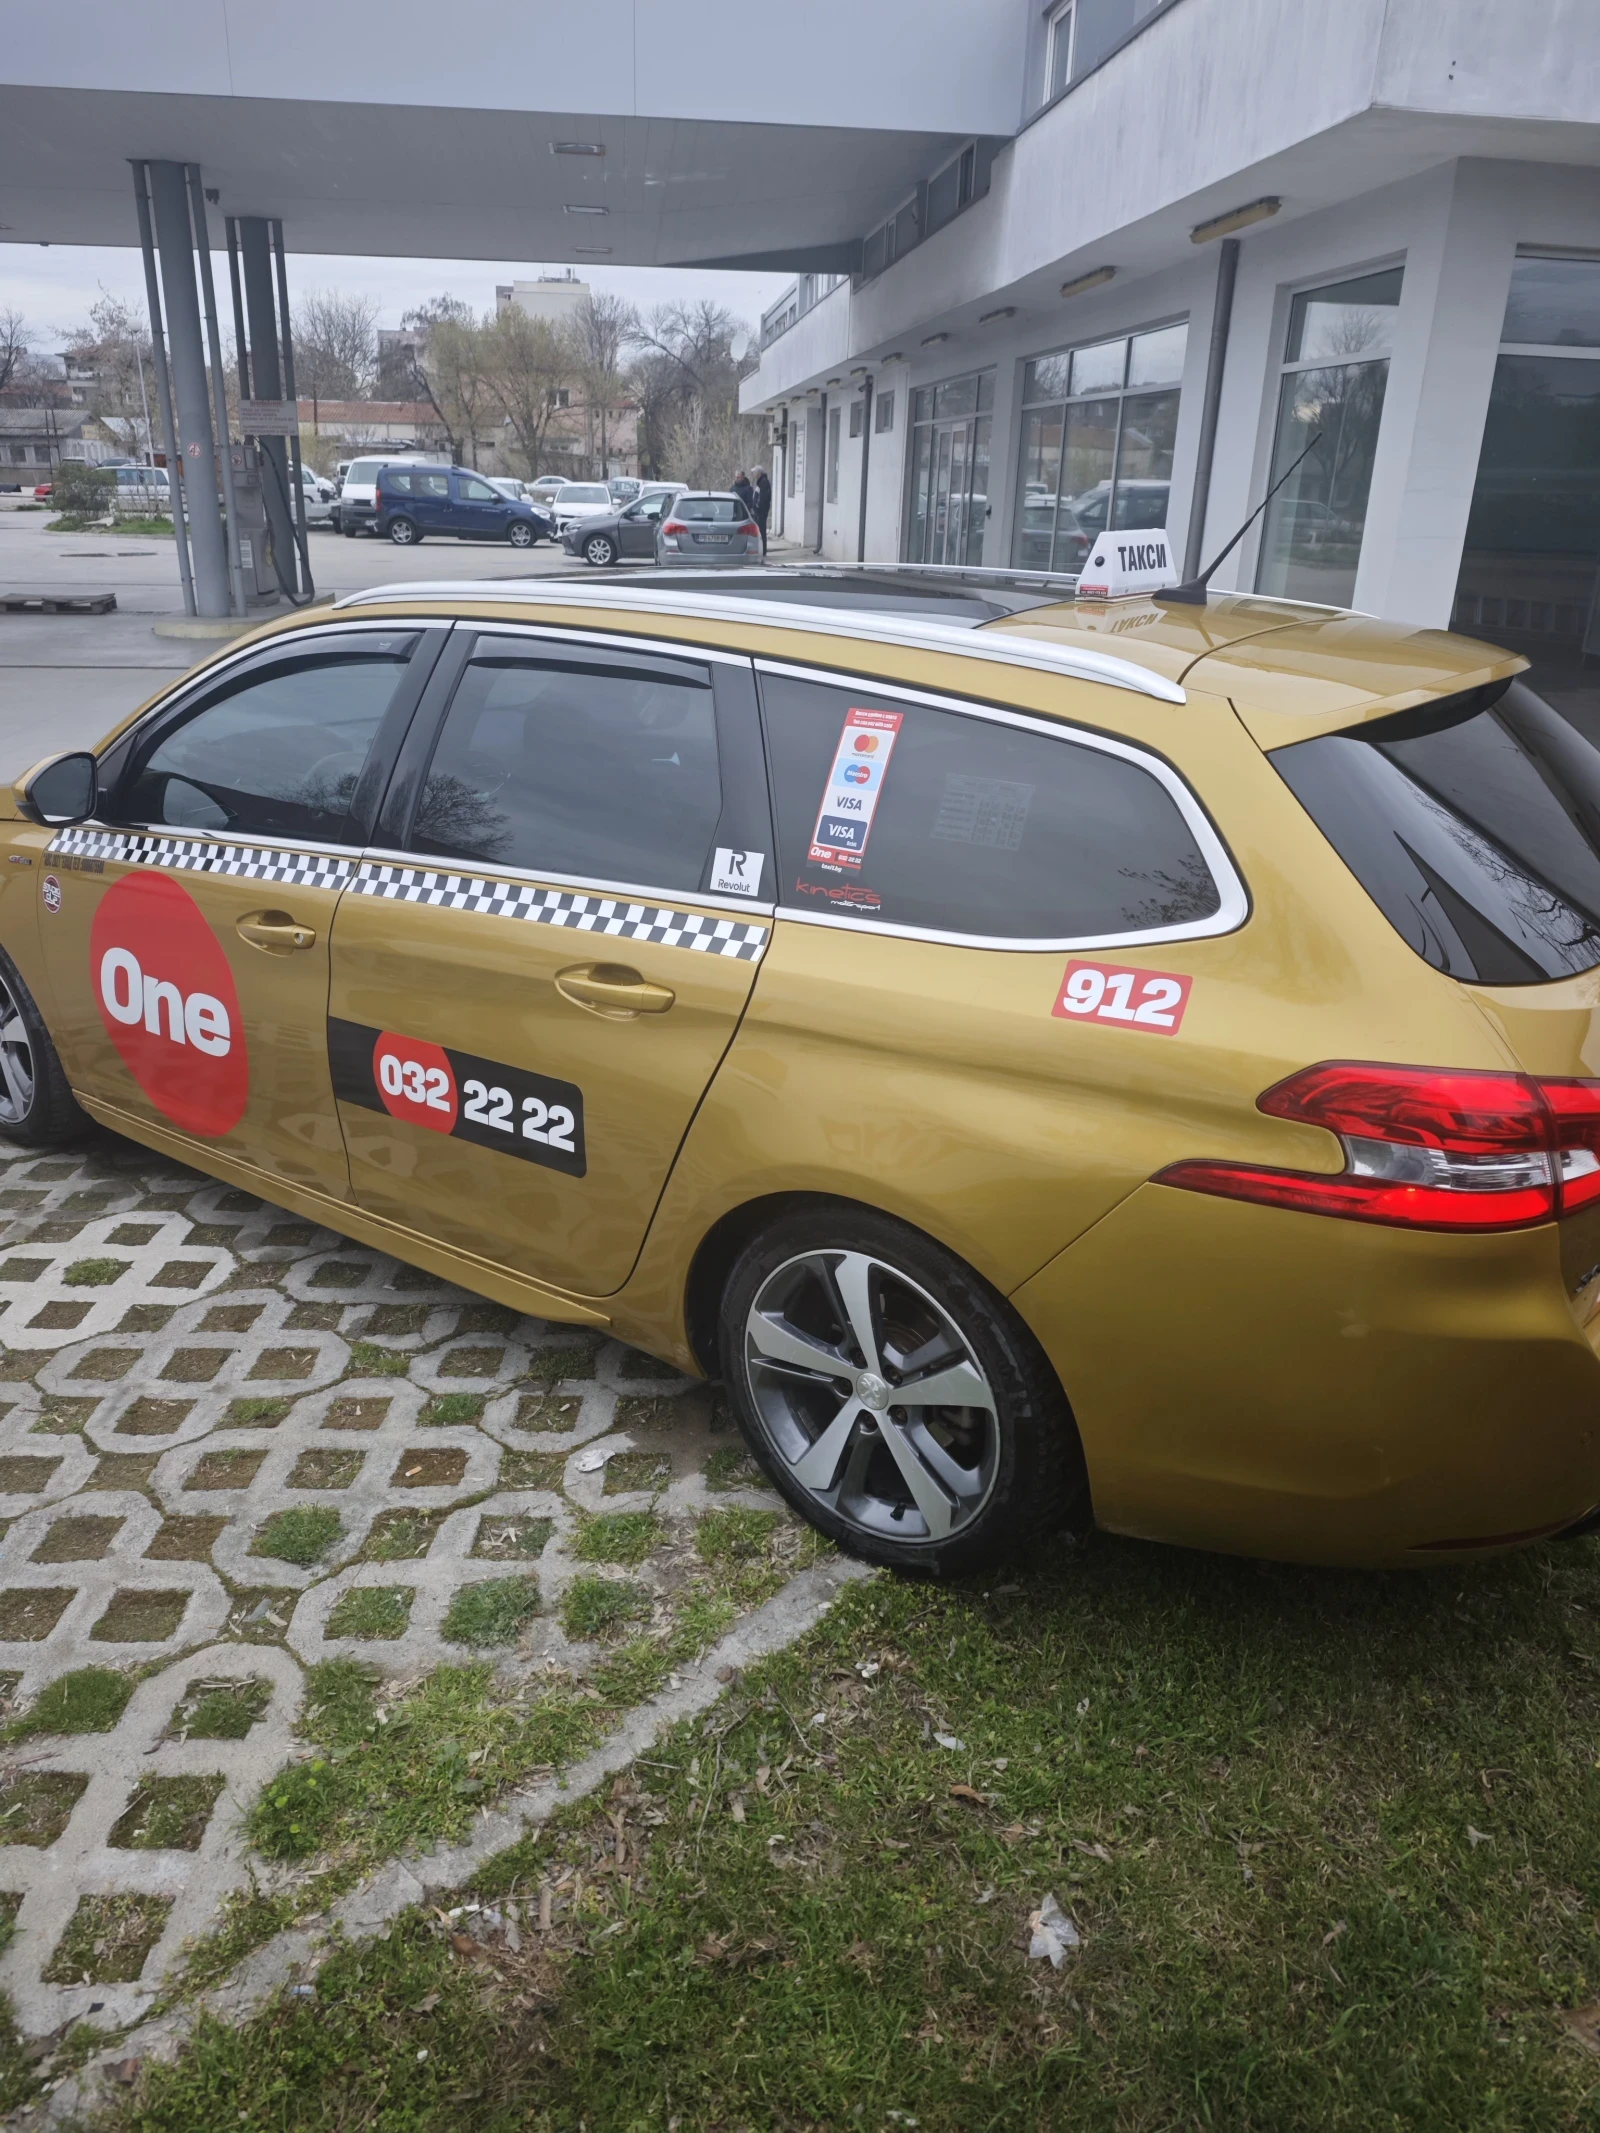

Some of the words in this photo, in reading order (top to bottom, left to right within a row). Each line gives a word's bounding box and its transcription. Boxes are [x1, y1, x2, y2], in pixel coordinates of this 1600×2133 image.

[1117, 543, 1167, 572] ТАКСИ
[847, 770, 868, 779] Maestro
[836, 796, 862, 811] VISA
[828, 823, 855, 840] VISA
[810, 846, 832, 859] One
[718, 879, 750, 892] Revolut
[796, 876, 881, 904] kinetics
[101, 947, 231, 1057] One
[1063, 969, 1182, 1027] 912
[380, 1055, 450, 1113] 032
[464, 1080, 514, 1133] 22
[522, 1097, 575, 1153] 22
